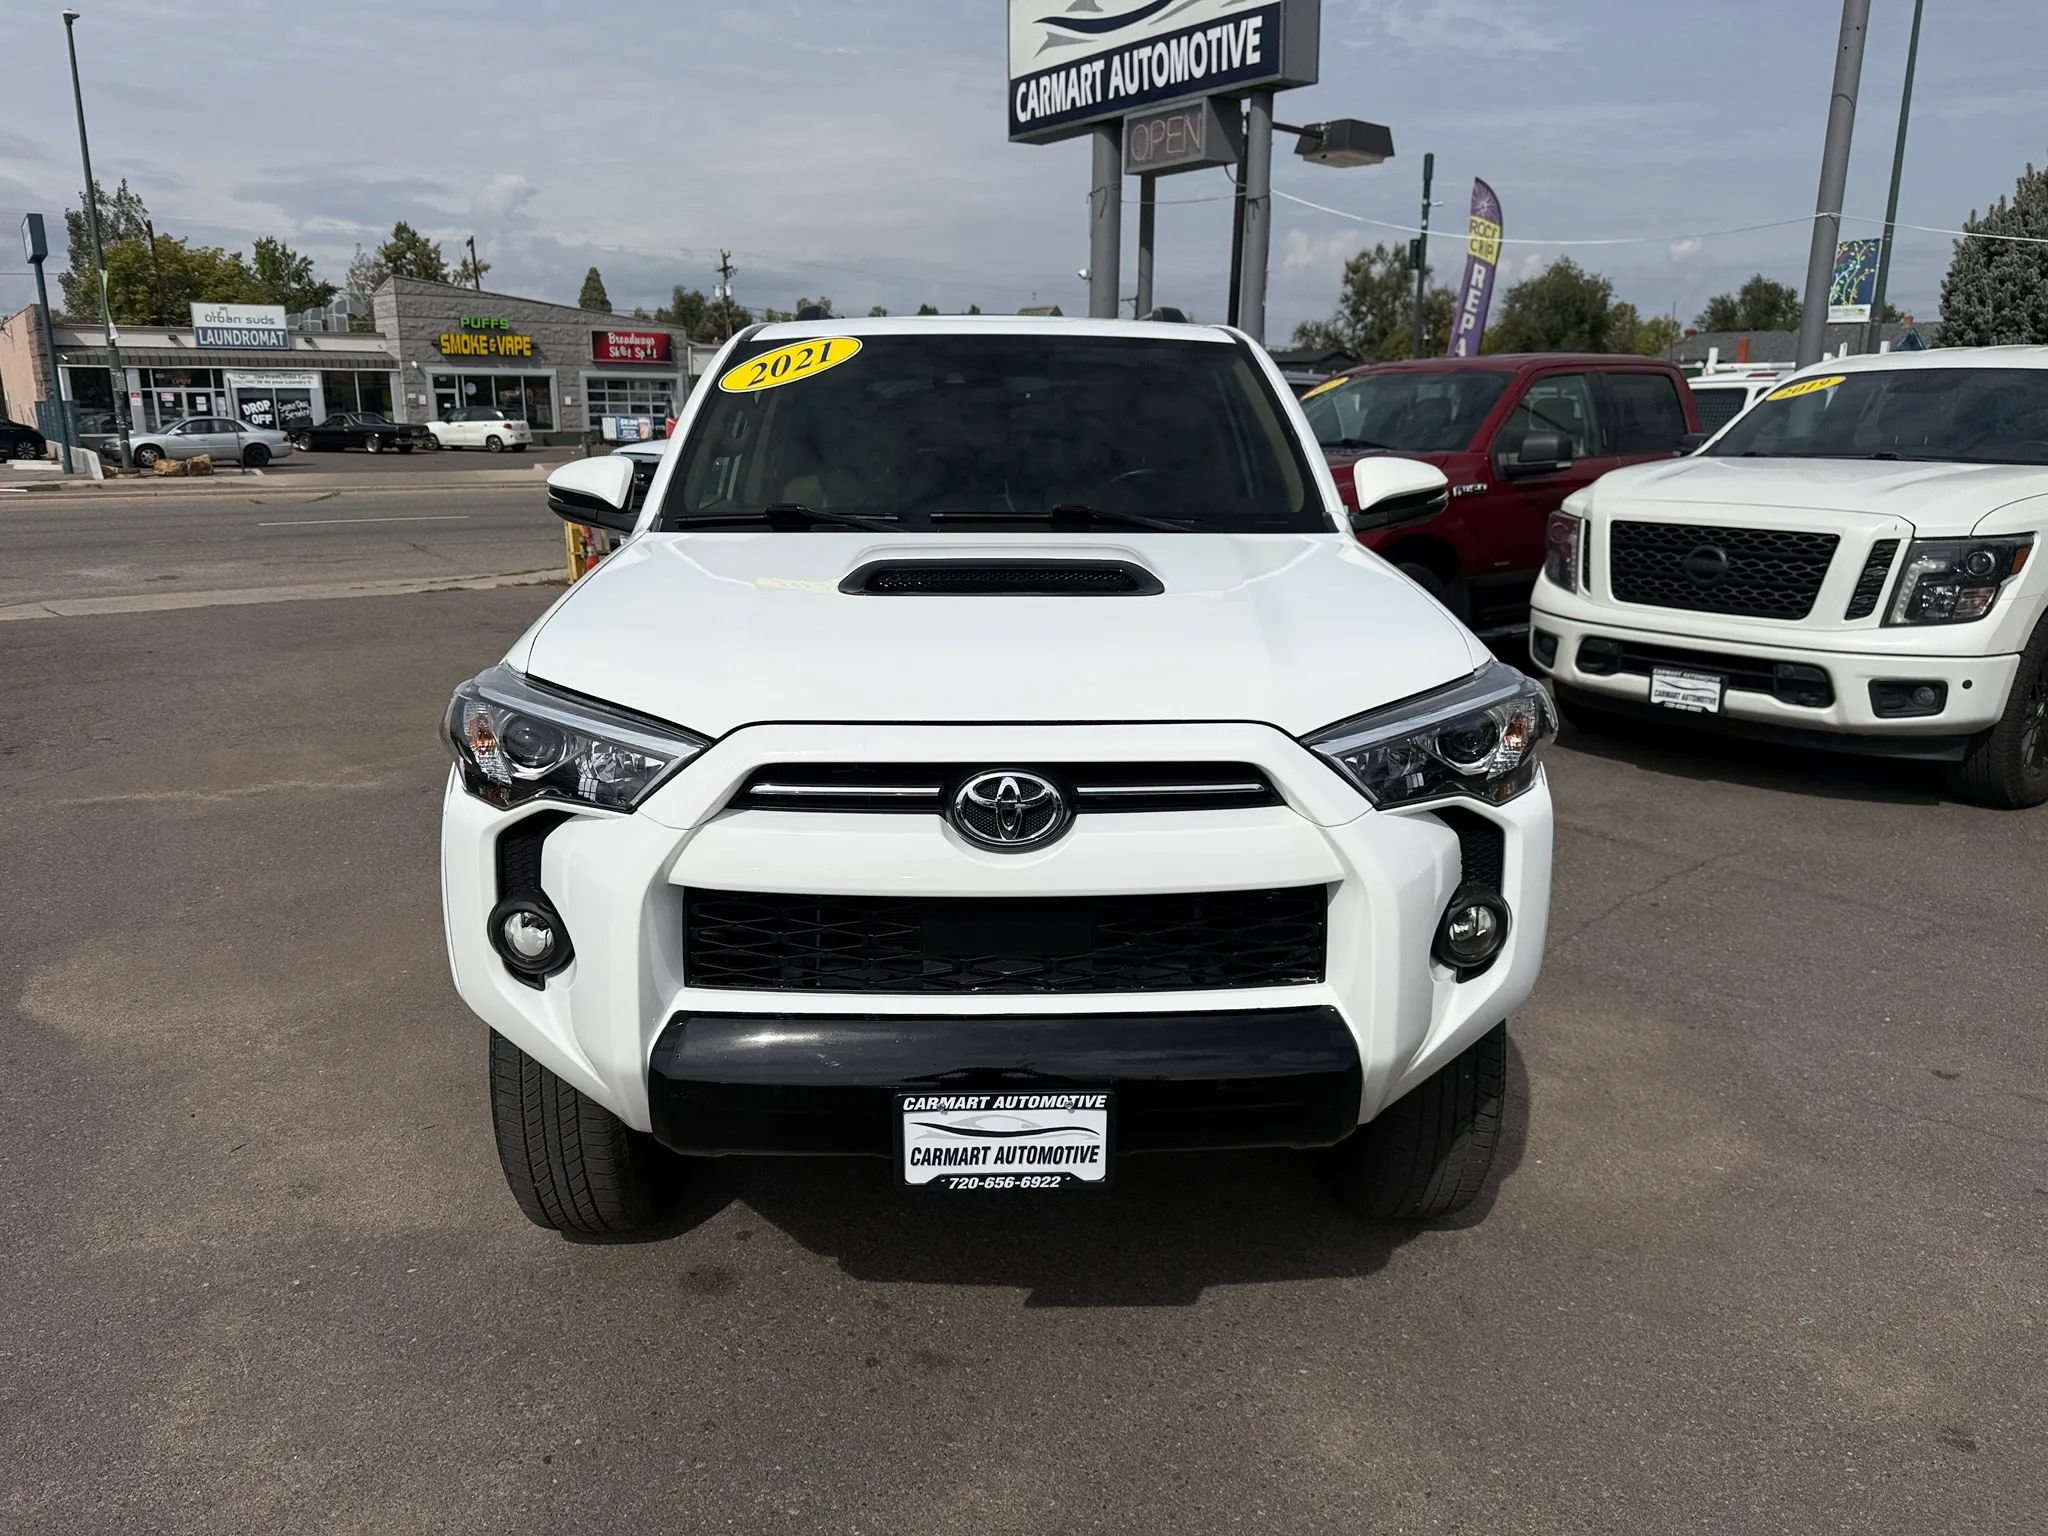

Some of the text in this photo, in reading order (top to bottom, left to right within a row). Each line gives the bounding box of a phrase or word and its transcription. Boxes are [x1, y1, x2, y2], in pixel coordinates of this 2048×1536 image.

[1016, 15, 1263, 123] CARMART AUTOMOTIVE
[1130, 112, 1202, 161] OPEN
[246, 315, 275, 325] suds
[460, 317, 510, 330] PUFFS
[198, 328, 284, 346] LAUNDROMAT
[440, 333, 532, 357] SMOKE & VAPE
[747, 341, 832, 387] 2021
[241, 400, 271, 415] DROP
[251, 414, 273, 425] OFF
[903, 1095, 1108, 1111] CARMART AUTOMOTIVE
[910, 1145, 1101, 1166] CARMART AUTOMOTIVE
[949, 1175, 1061, 1190] 720-656-6922
